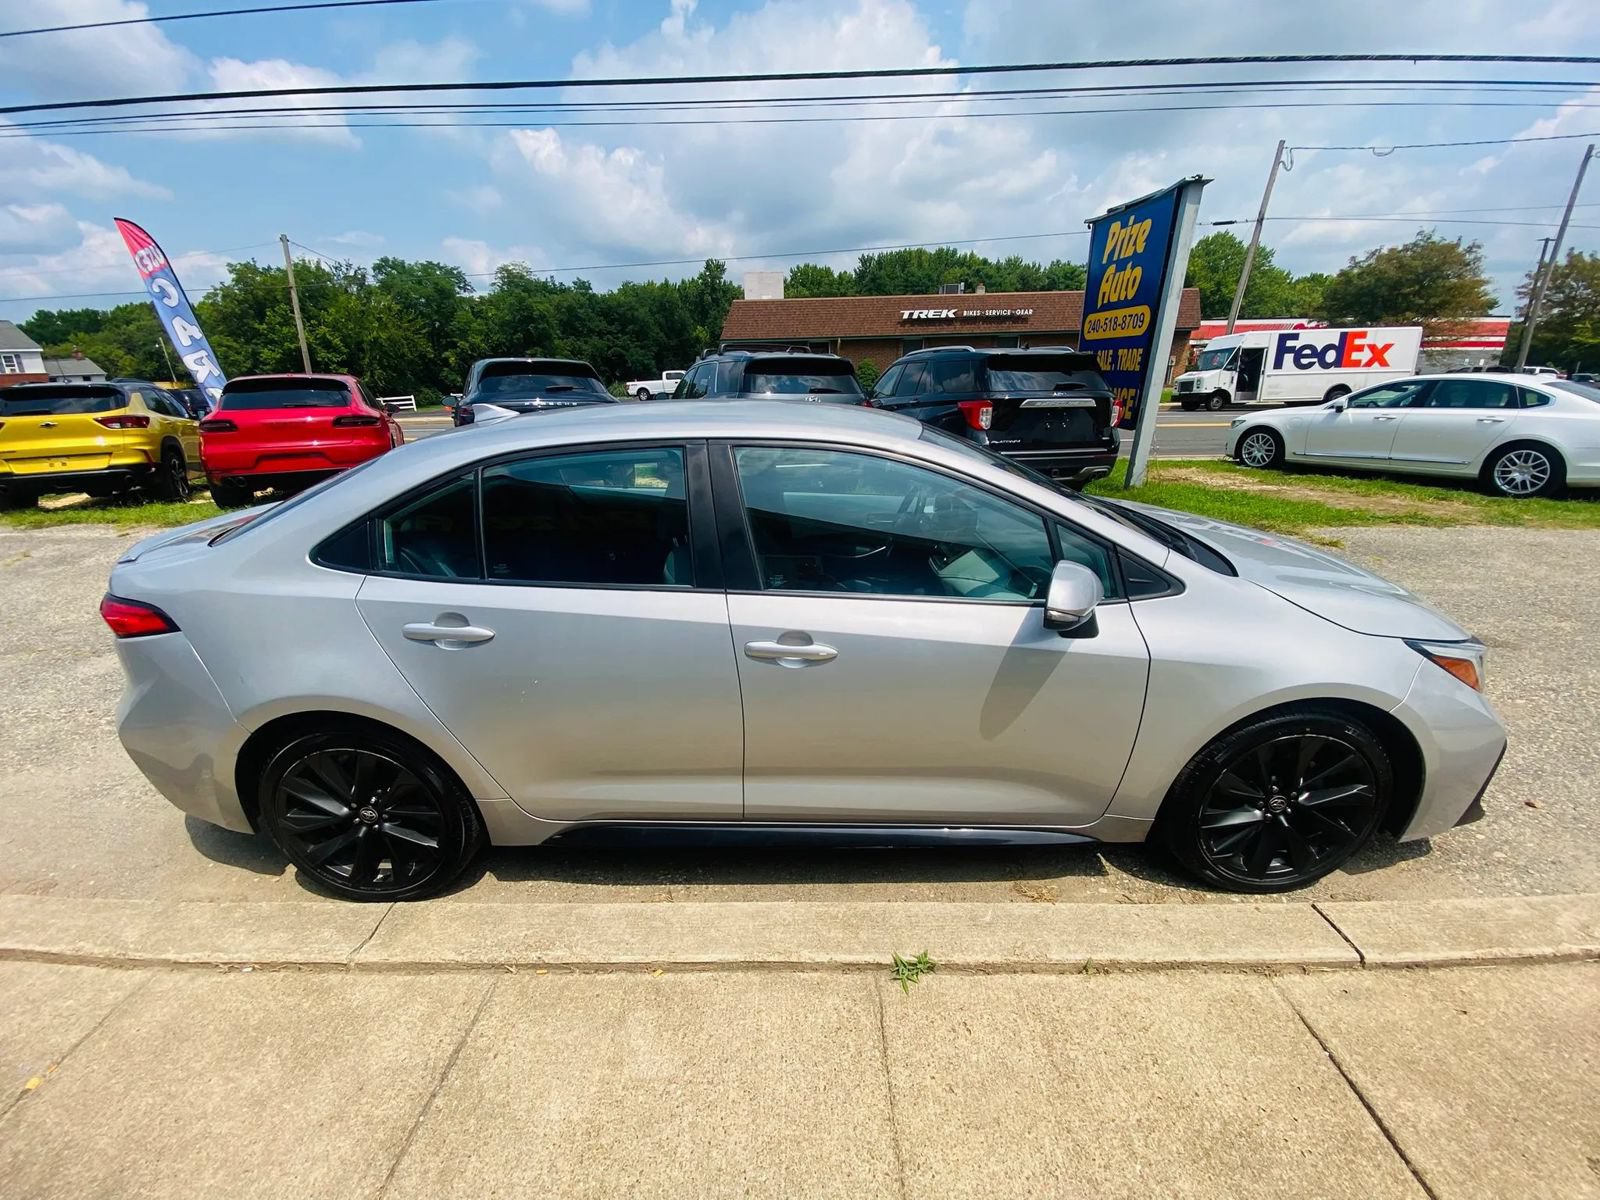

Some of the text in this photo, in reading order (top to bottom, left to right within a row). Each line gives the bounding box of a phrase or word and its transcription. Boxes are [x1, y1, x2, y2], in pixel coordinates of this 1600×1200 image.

[1102, 215, 1152, 264] Prize
[1097, 261, 1142, 309] Auto
[900, 309, 958, 319] TREK
[1087, 312, 1145, 333] 240-518-8709
[1117, 348, 1143, 371] TRADE
[1273, 331, 1395, 370] FedEx
